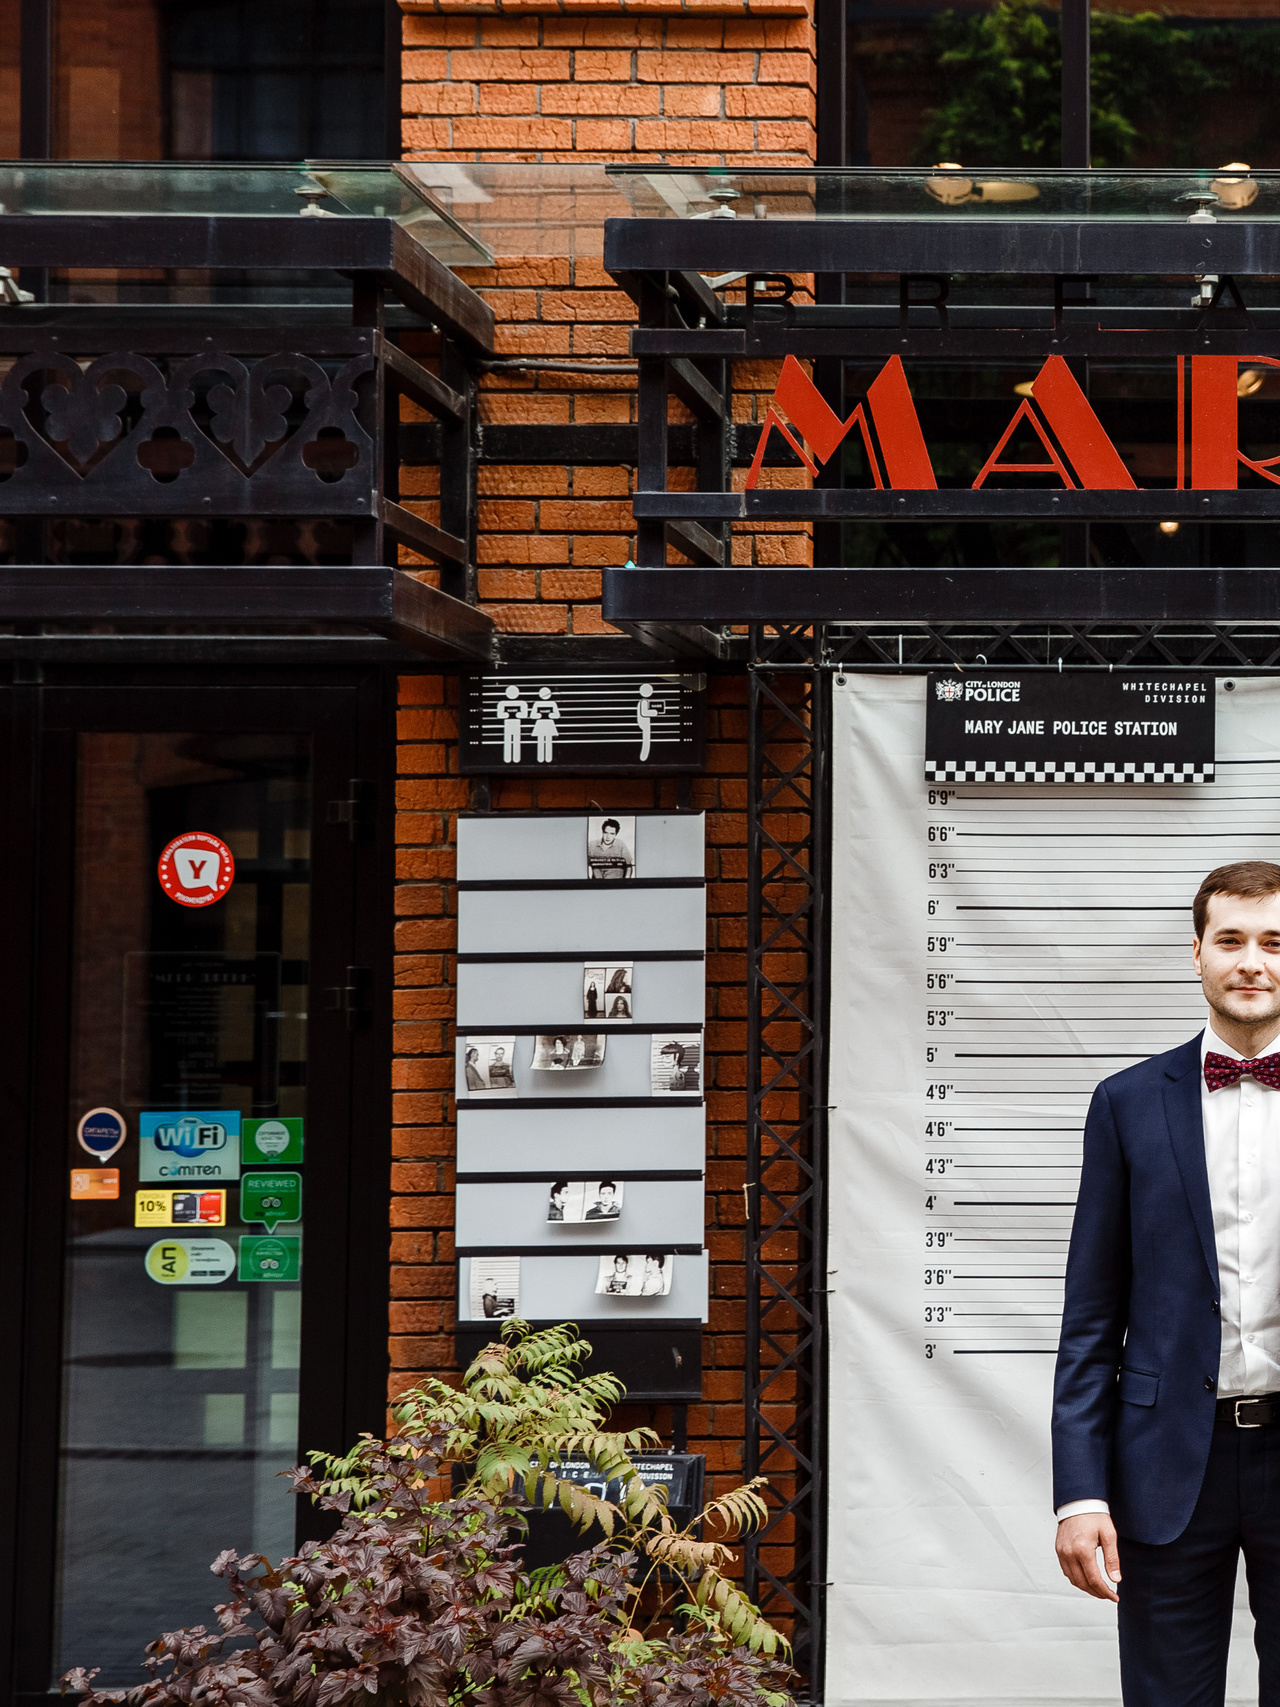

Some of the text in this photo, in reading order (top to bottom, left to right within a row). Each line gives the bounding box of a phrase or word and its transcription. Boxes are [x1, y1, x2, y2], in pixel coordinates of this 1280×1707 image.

[987, 681, 1021, 689] LONDON
[1122, 682, 1207, 692] WHITECHAPEL
[965, 688, 1021, 702] POLICE
[1144, 694, 1206, 703] DIVISION
[964, 720, 1177, 736] MARY JANE POLICE STATION
[188, 860, 208, 879] Y
[248, 1179, 297, 1188] REVIEWED
[139, 1200, 167, 1212] 10%
[561, 1461, 590, 1469] LONDON
[638, 1472, 673, 1480] DIVISION
